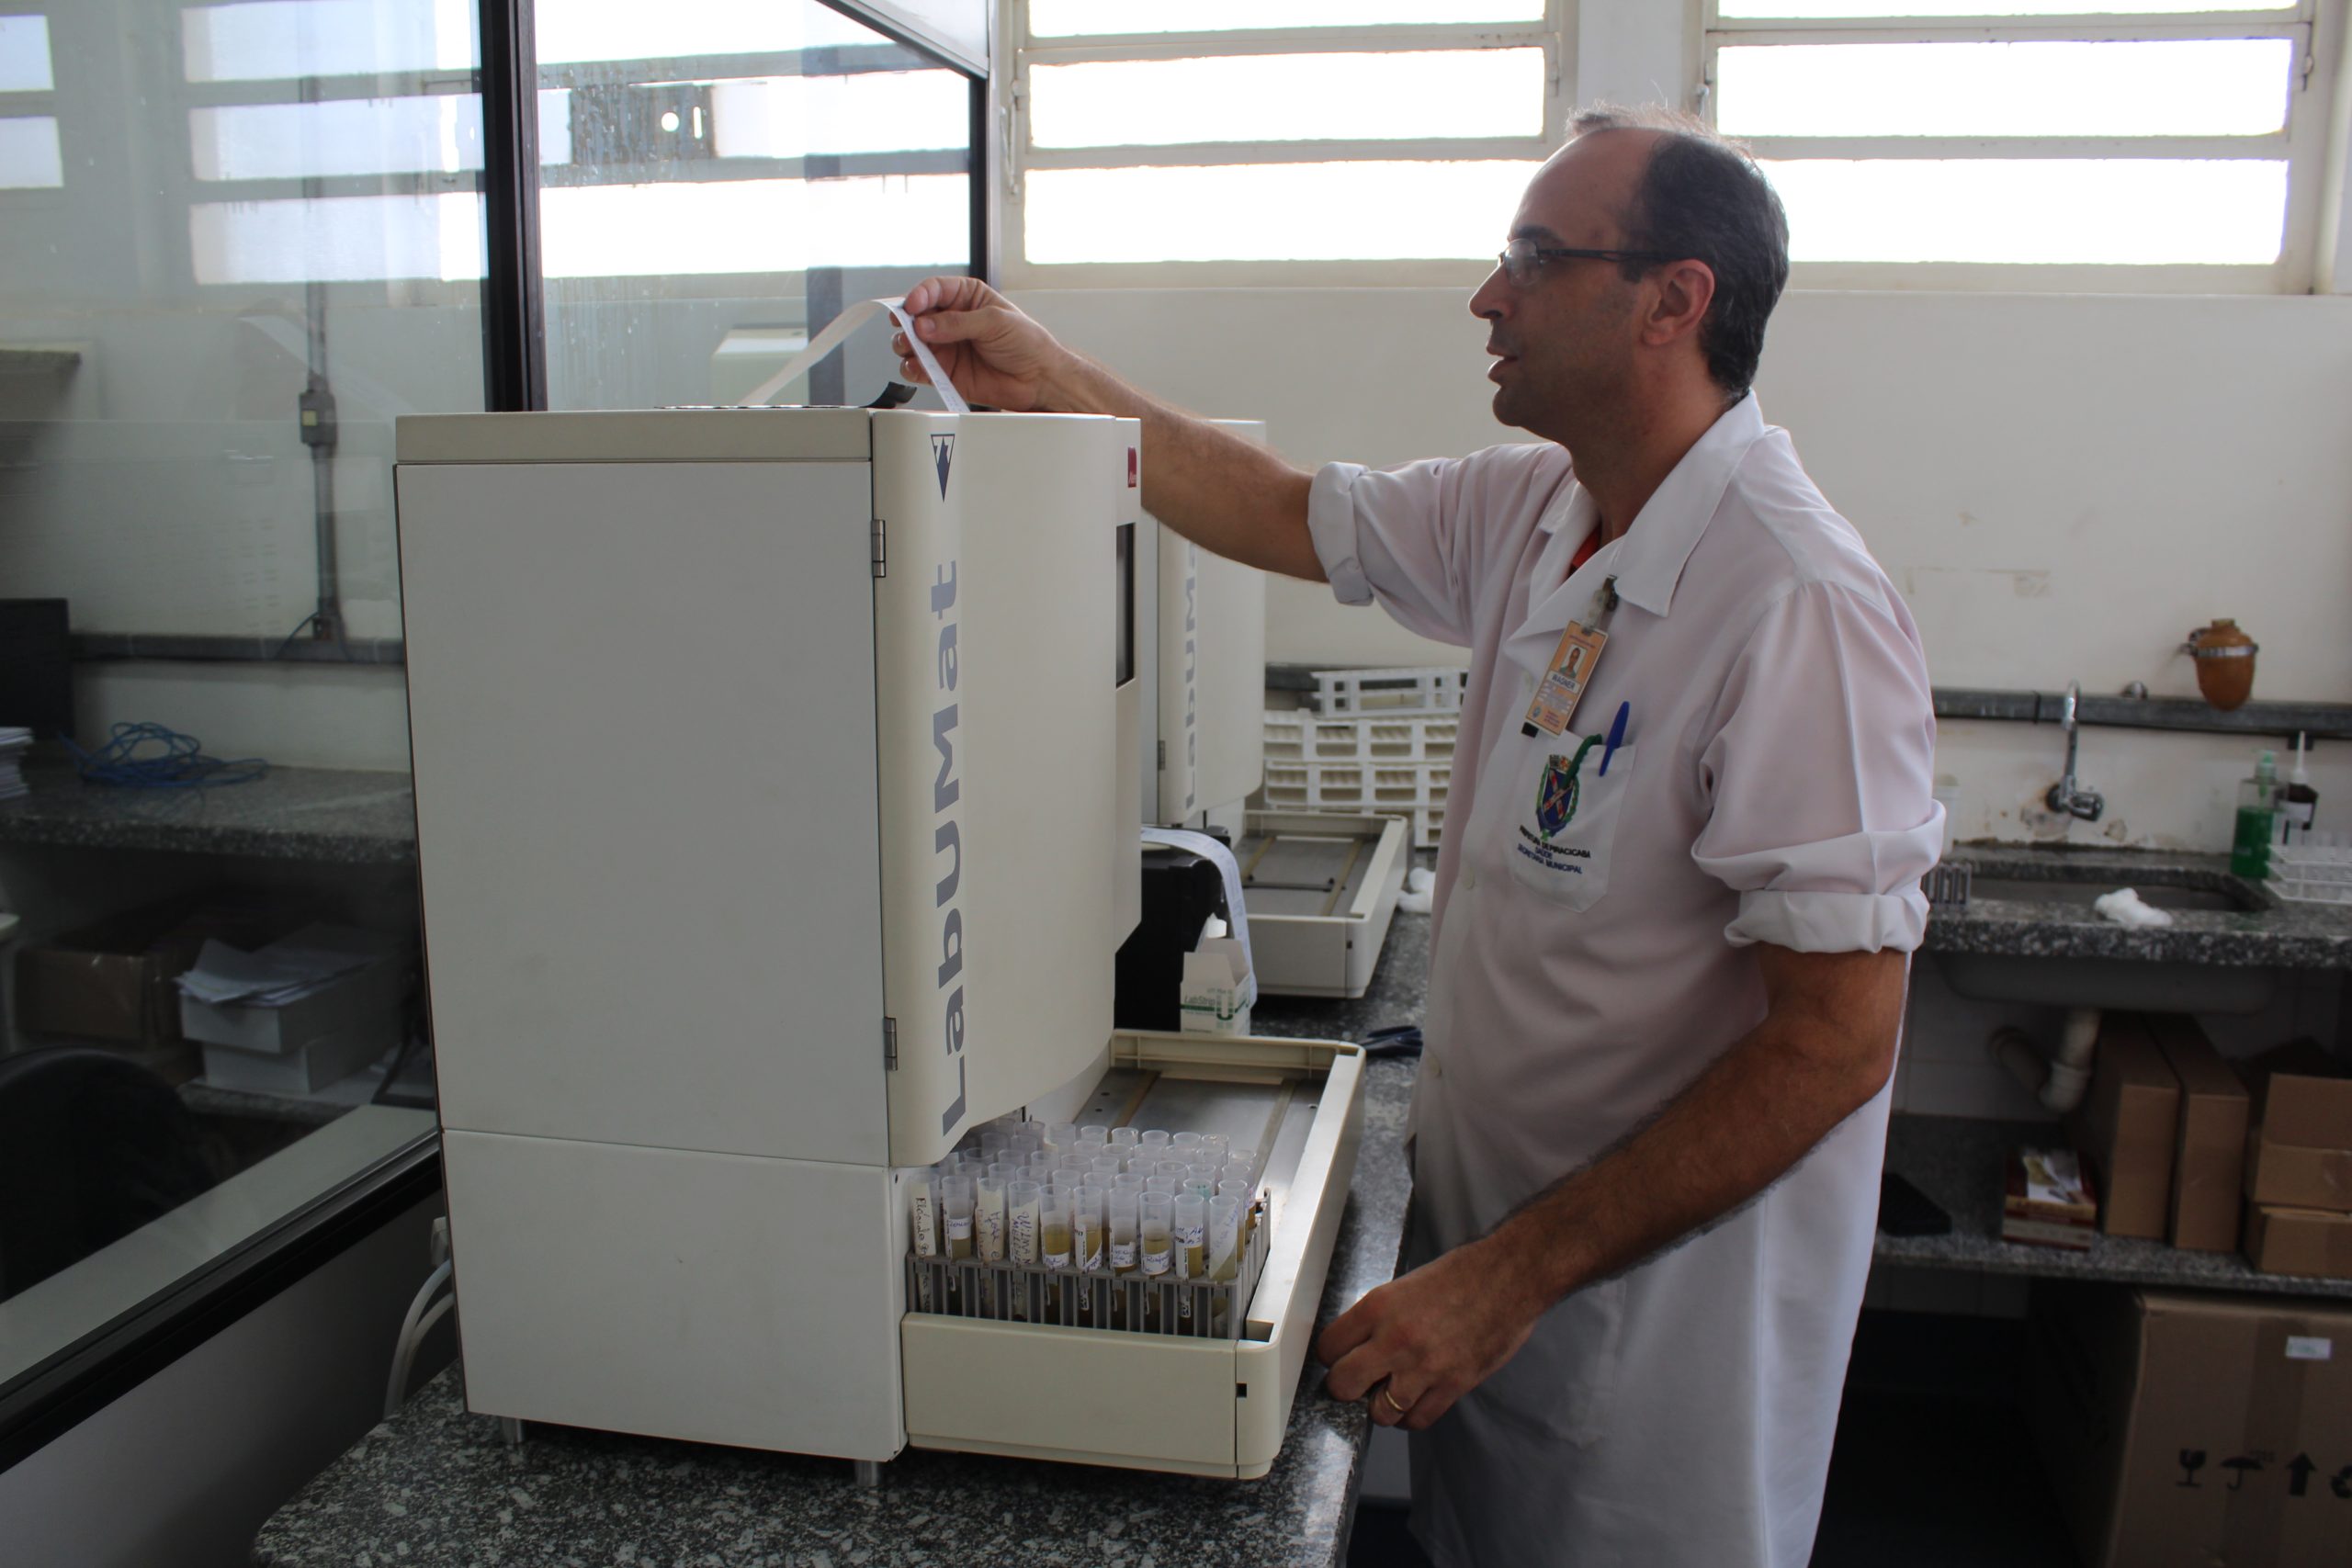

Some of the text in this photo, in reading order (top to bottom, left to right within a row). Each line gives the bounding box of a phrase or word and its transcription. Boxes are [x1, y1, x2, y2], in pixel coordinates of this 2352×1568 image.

[1185, 540, 1196, 810] LabUMa
[931, 559, 967, 1137] LabUMat
[1545, 859, 1583, 874] MUNICIPAL
[1549, 843, 1591, 859] PIRACICABA
